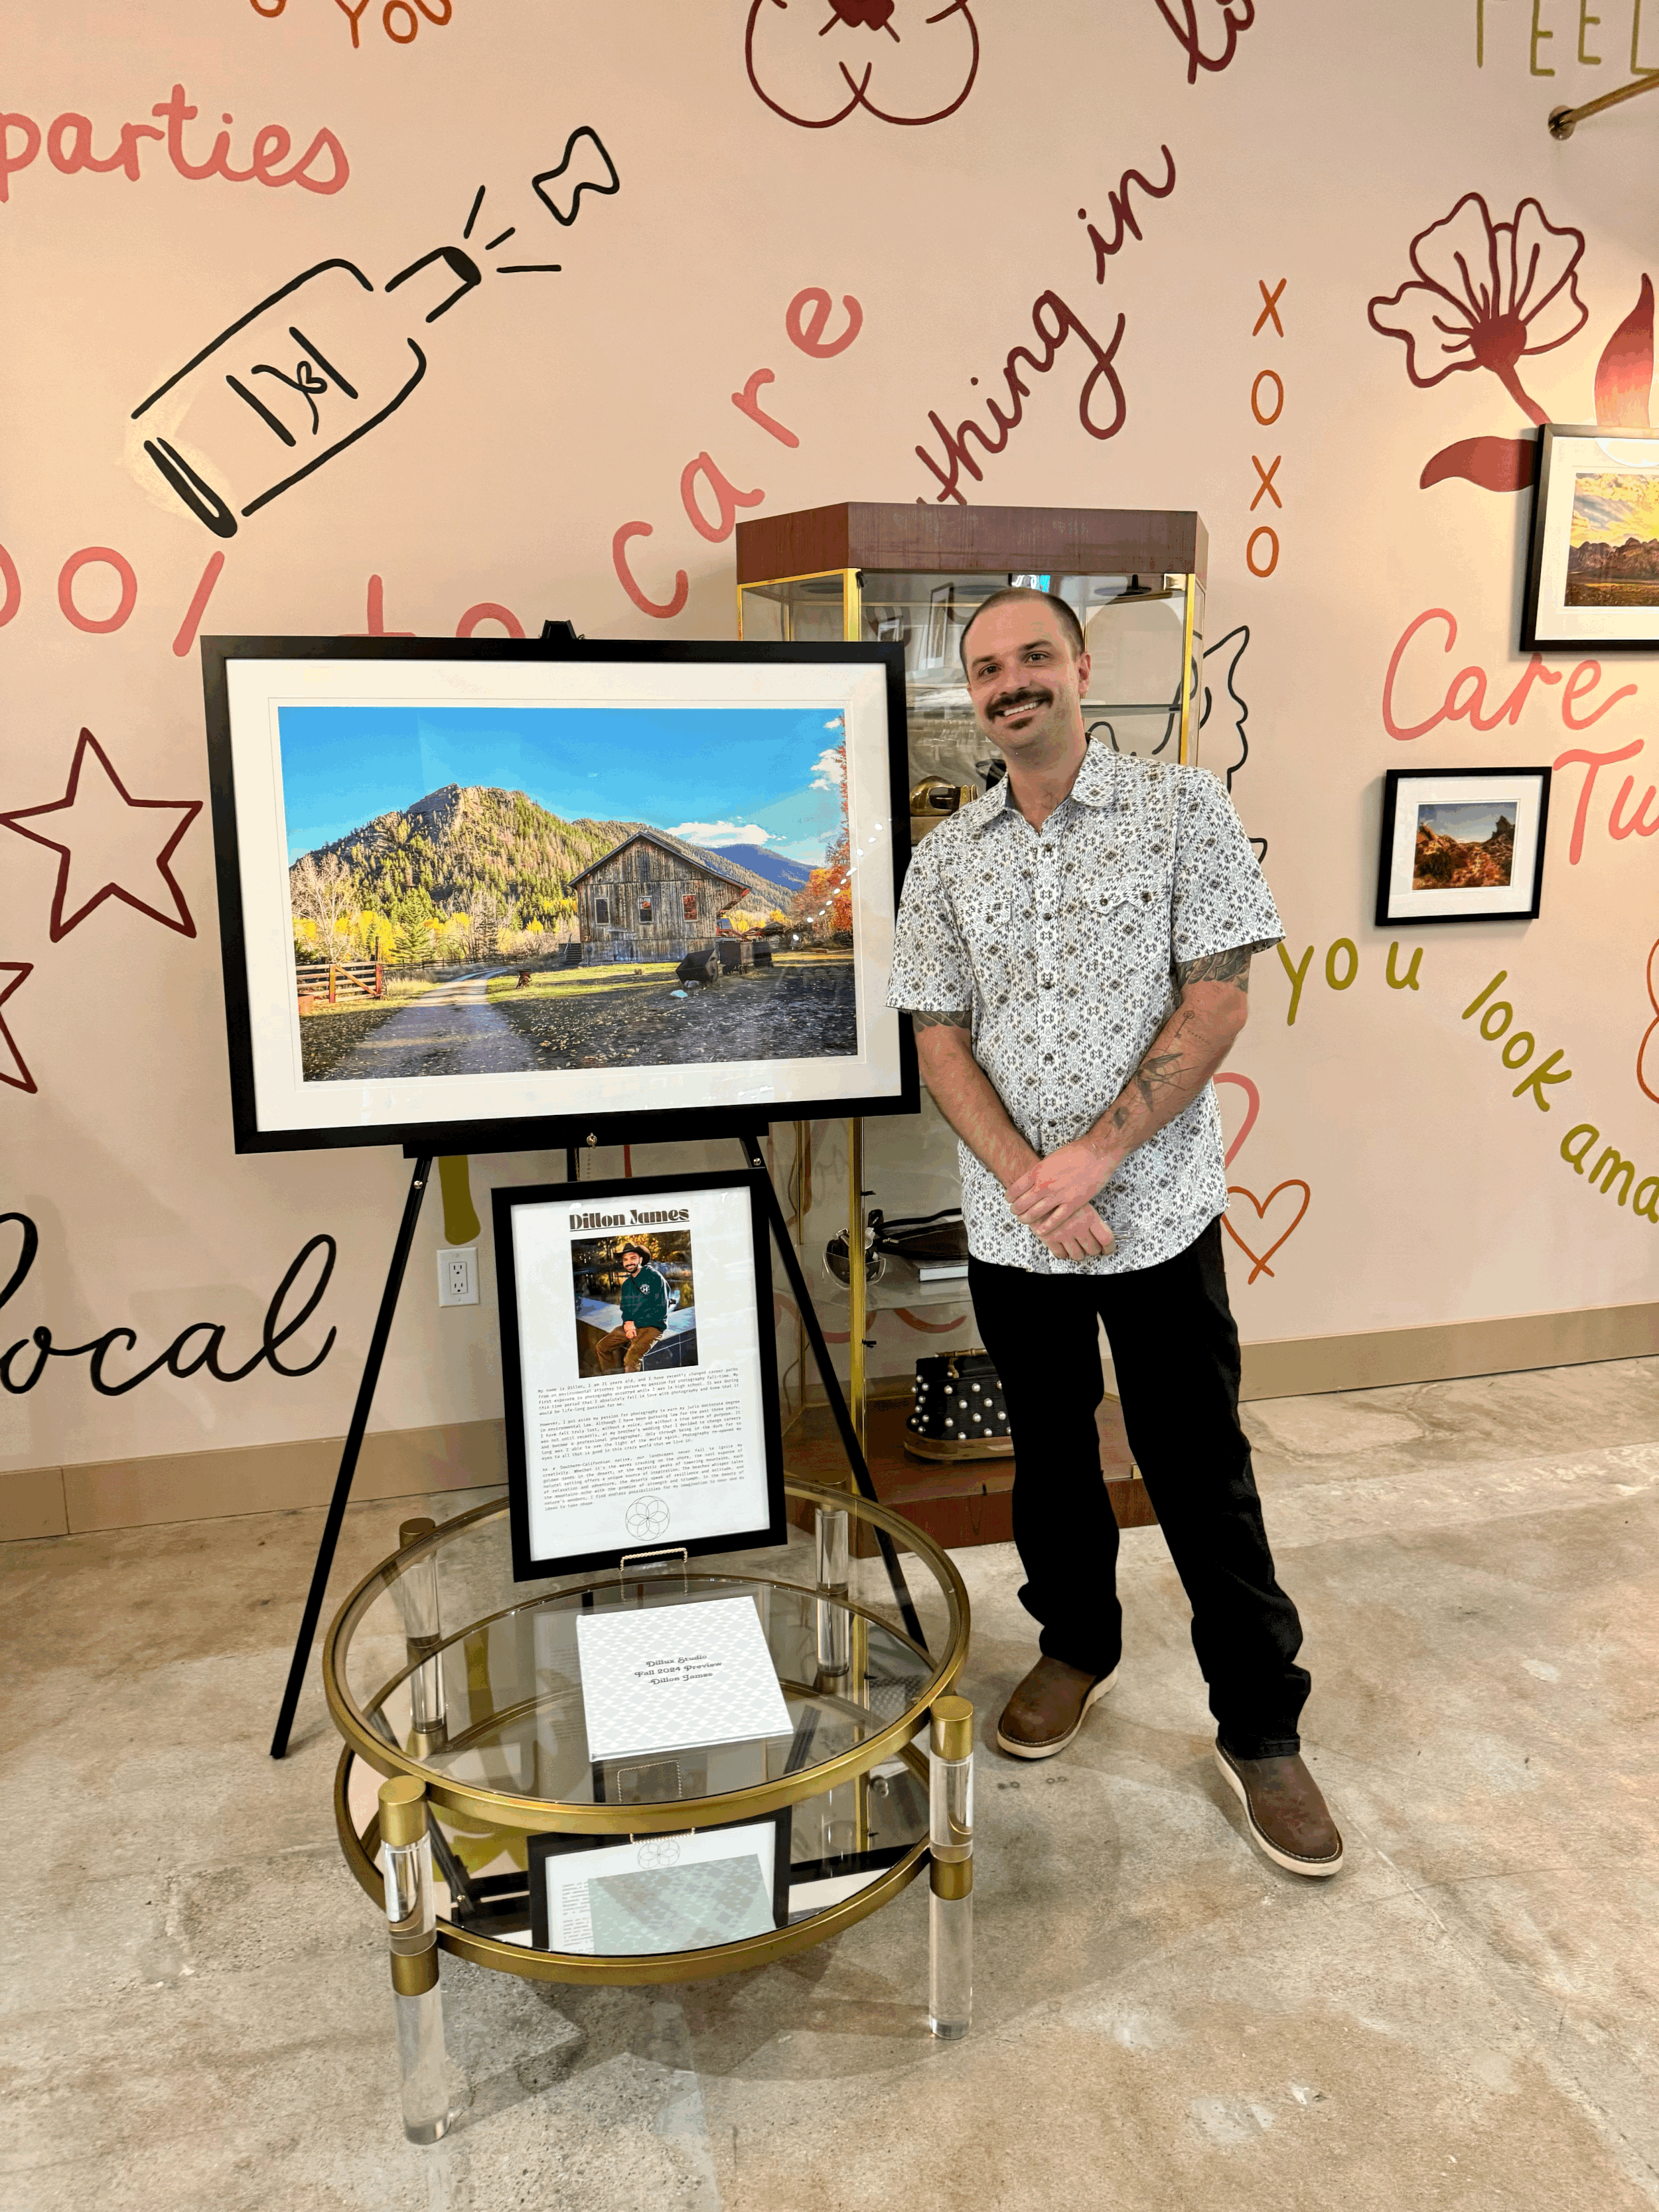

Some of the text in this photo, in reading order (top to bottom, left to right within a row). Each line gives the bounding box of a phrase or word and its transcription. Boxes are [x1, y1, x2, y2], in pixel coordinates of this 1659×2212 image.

[0, 84, 349, 202] parties
[1078, 143, 1176, 284] in
[1382, 608, 1638, 741] Care
[1277, 937, 1423, 1027] you
[1461, 970, 1572, 1112] look
[569, 1209, 689, 1230] Dillon James
[678, 1655, 707, 1664] Studio
[683, 1672, 713, 1682] James
[684, 1662, 722, 1672] Preview
